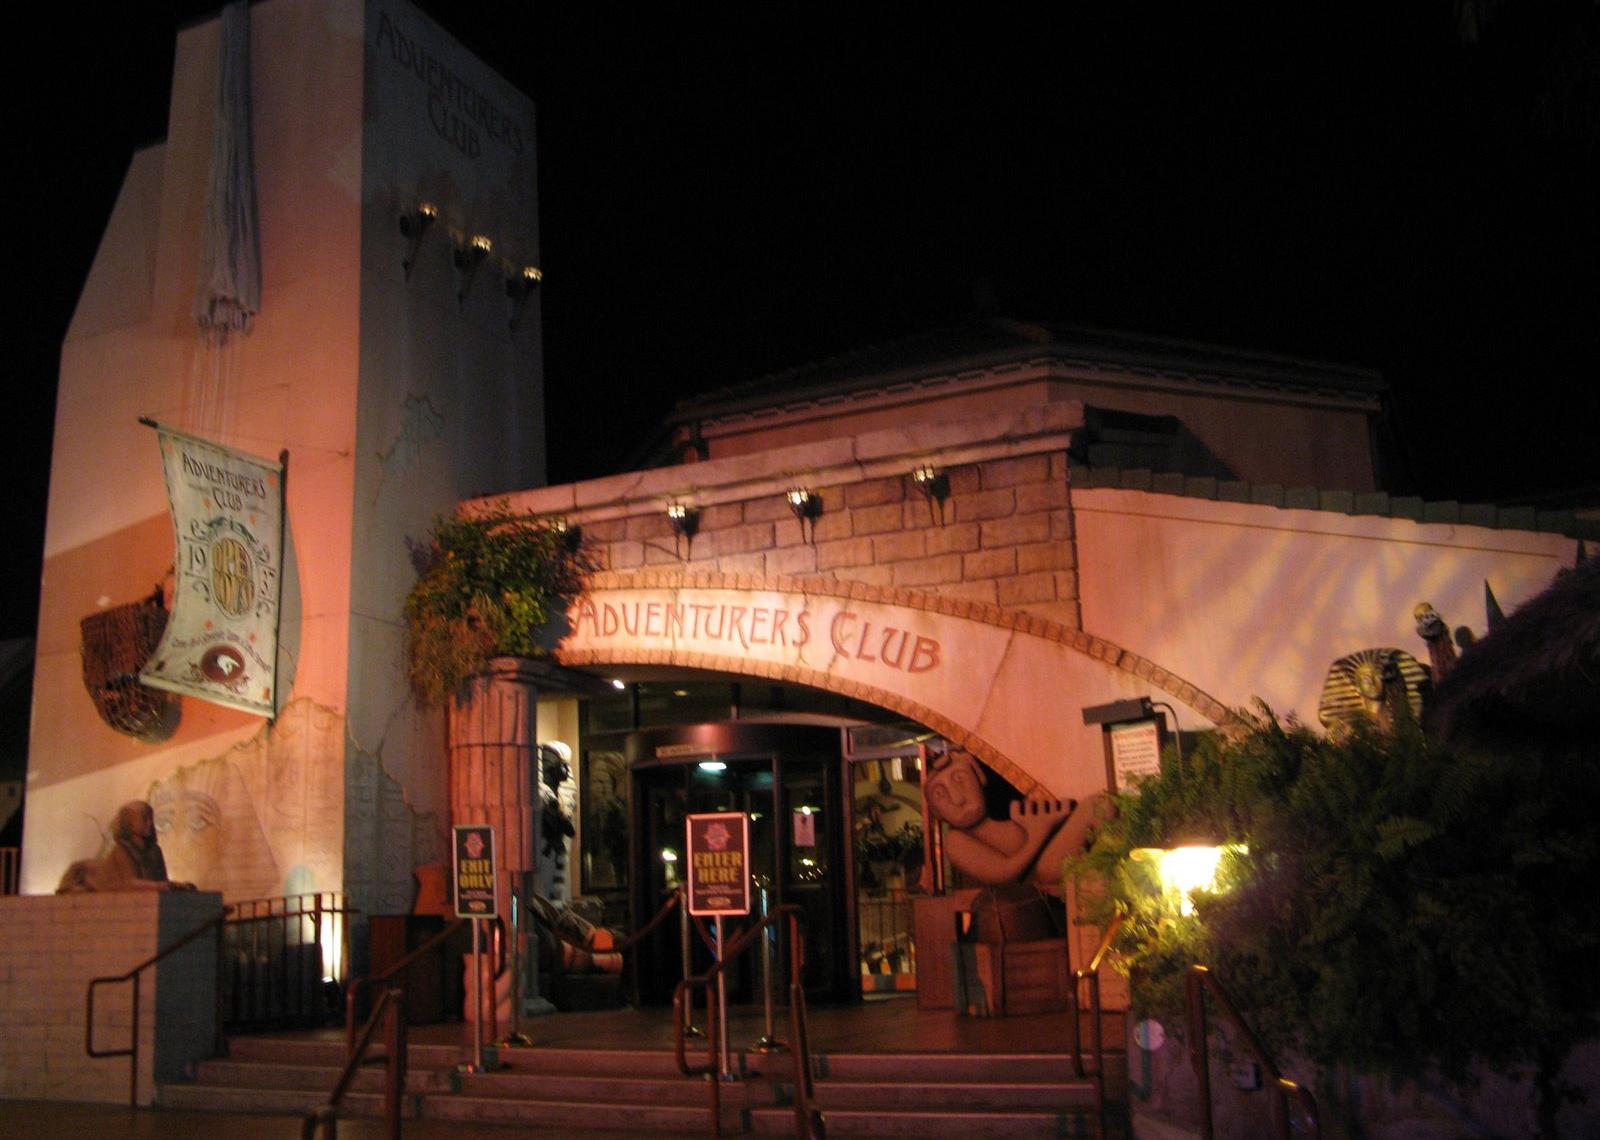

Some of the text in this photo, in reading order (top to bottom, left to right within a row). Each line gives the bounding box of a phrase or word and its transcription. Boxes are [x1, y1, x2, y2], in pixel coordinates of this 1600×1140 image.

[428, 91, 481, 158] CLUB
[182, 452, 266, 499] ADVENTURERS
[212, 487, 243, 512] CLUB
[571, 600, 942, 674] ADVENTURERS CLUB
[460, 859, 490, 874] EXIT
[693, 850, 742, 868] ENTER
[459, 873, 493, 889] ONLY
[698, 867, 738, 884] HERE
